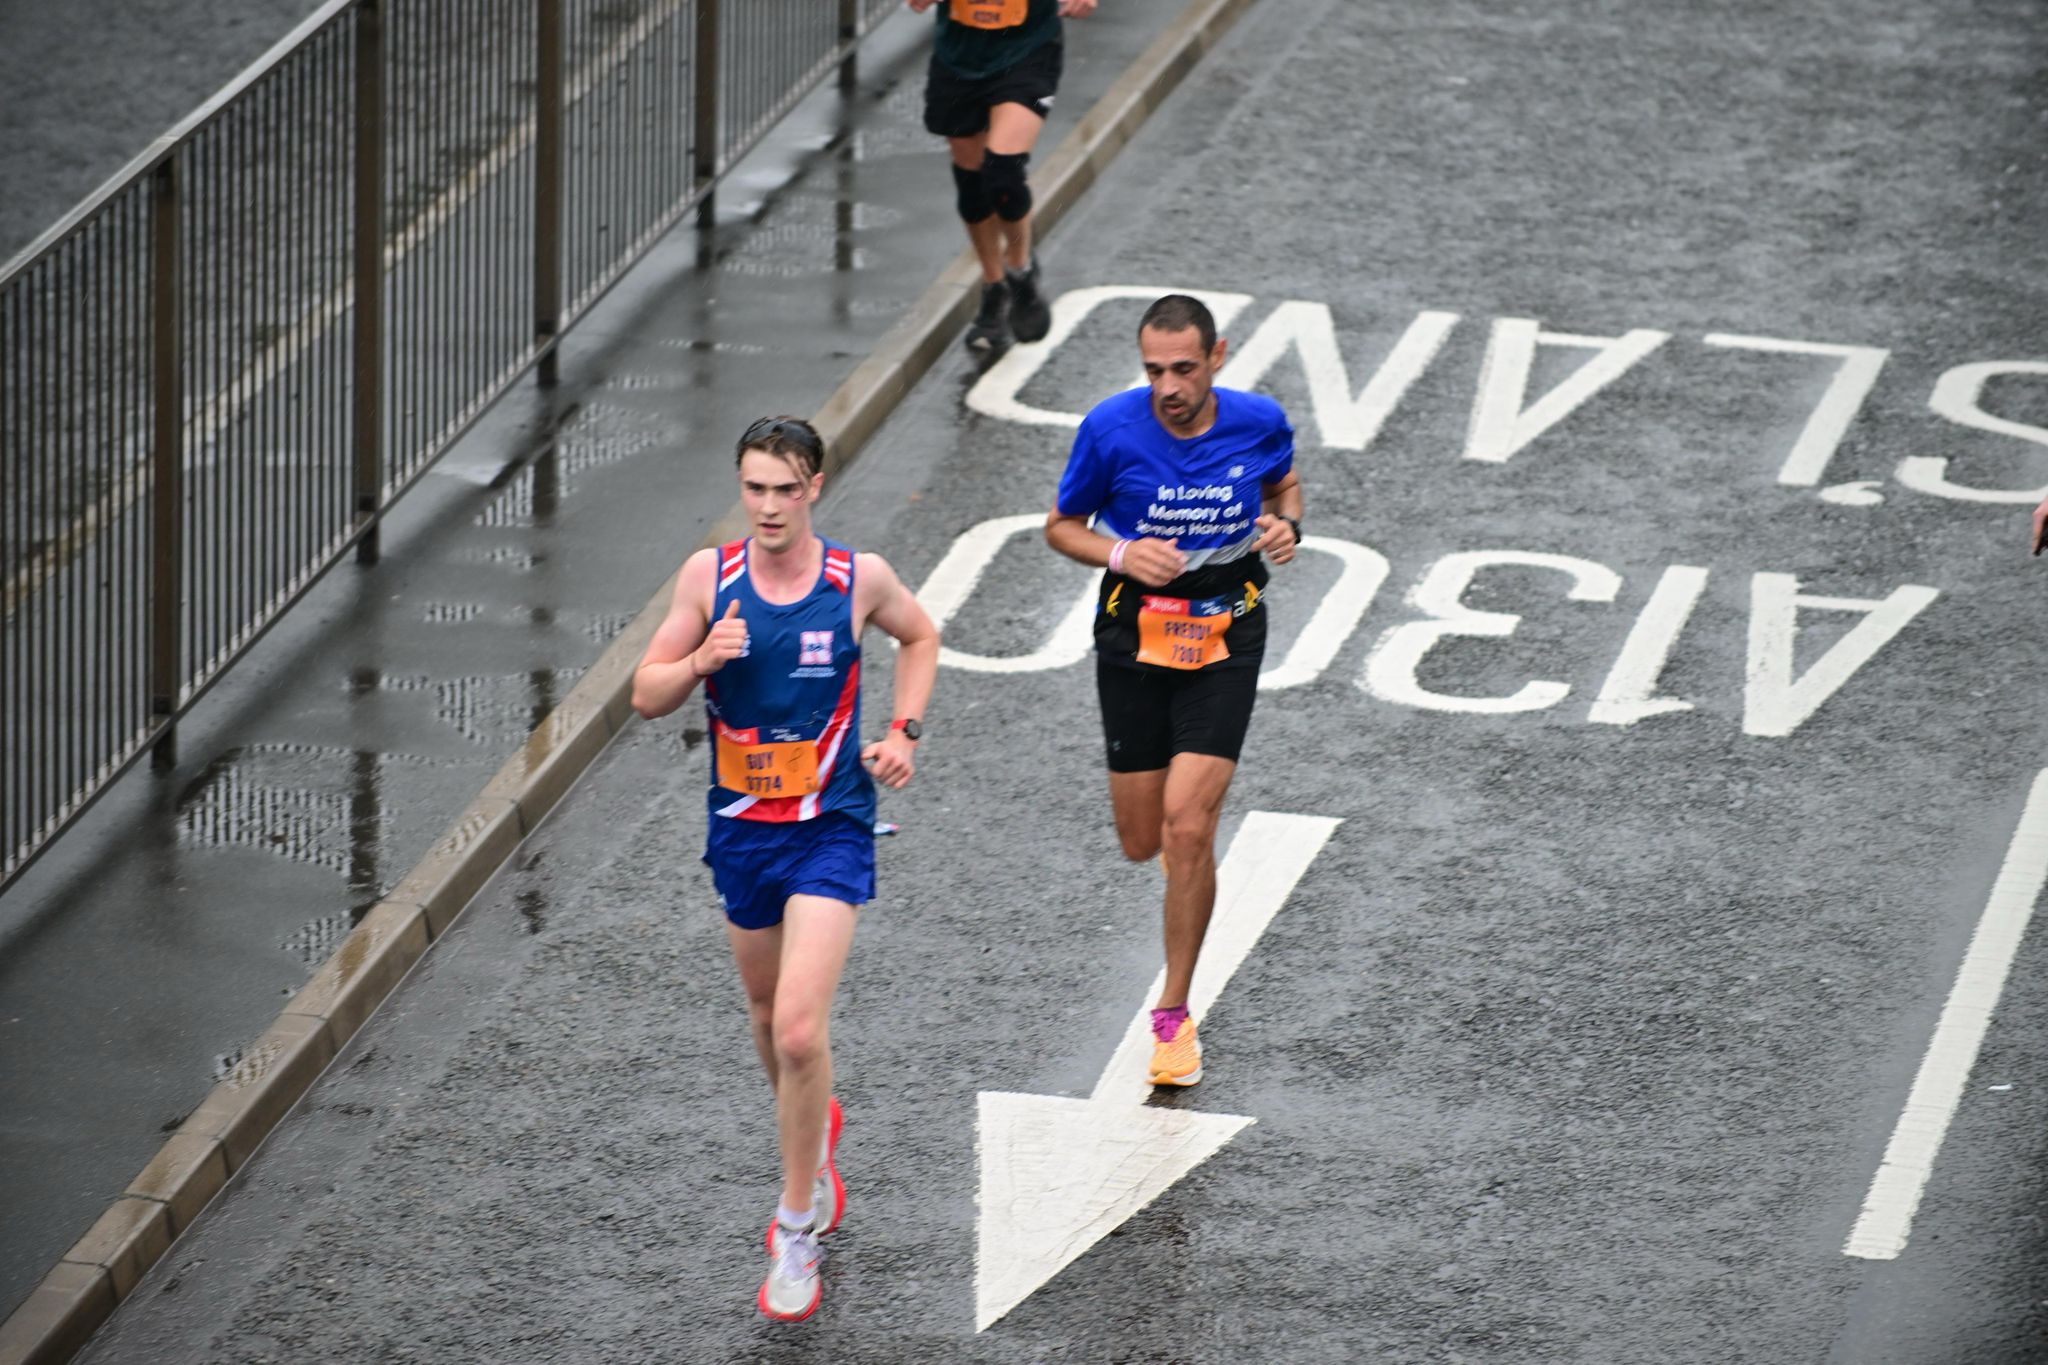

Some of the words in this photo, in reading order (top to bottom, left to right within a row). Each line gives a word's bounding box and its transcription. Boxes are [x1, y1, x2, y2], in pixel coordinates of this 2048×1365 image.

[1157, 484, 1176, 501] In
[1177, 484, 1233, 502] Loving
[1148, 503, 1221, 522] Memory
[1223, 501, 1243, 518] of
[744, 751, 774, 770] GUY
